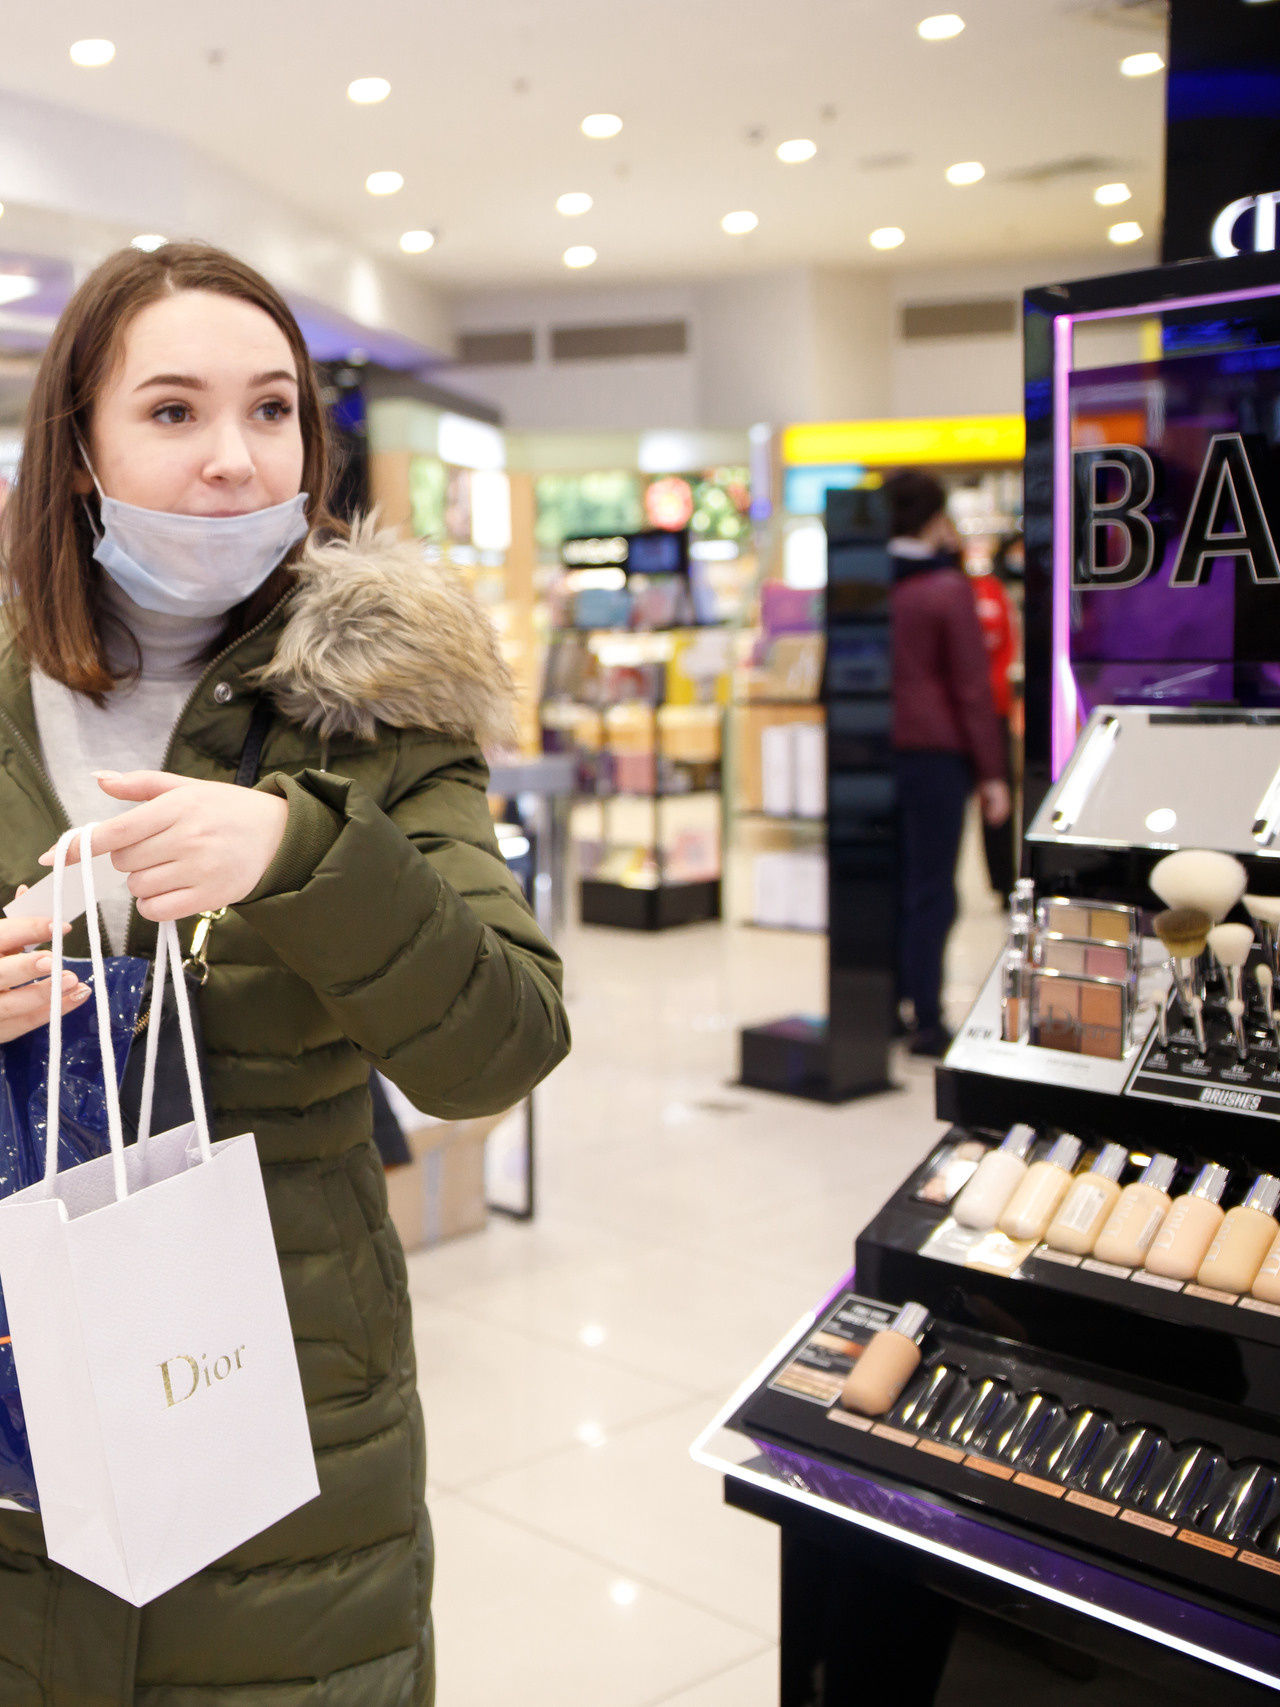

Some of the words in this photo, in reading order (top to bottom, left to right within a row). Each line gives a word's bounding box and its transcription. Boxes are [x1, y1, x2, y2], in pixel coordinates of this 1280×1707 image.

[1070, 432, 1280, 591] BA
[1200, 1087, 1262, 1111] BRUSHES
[155, 1345, 246, 1411] Dior
